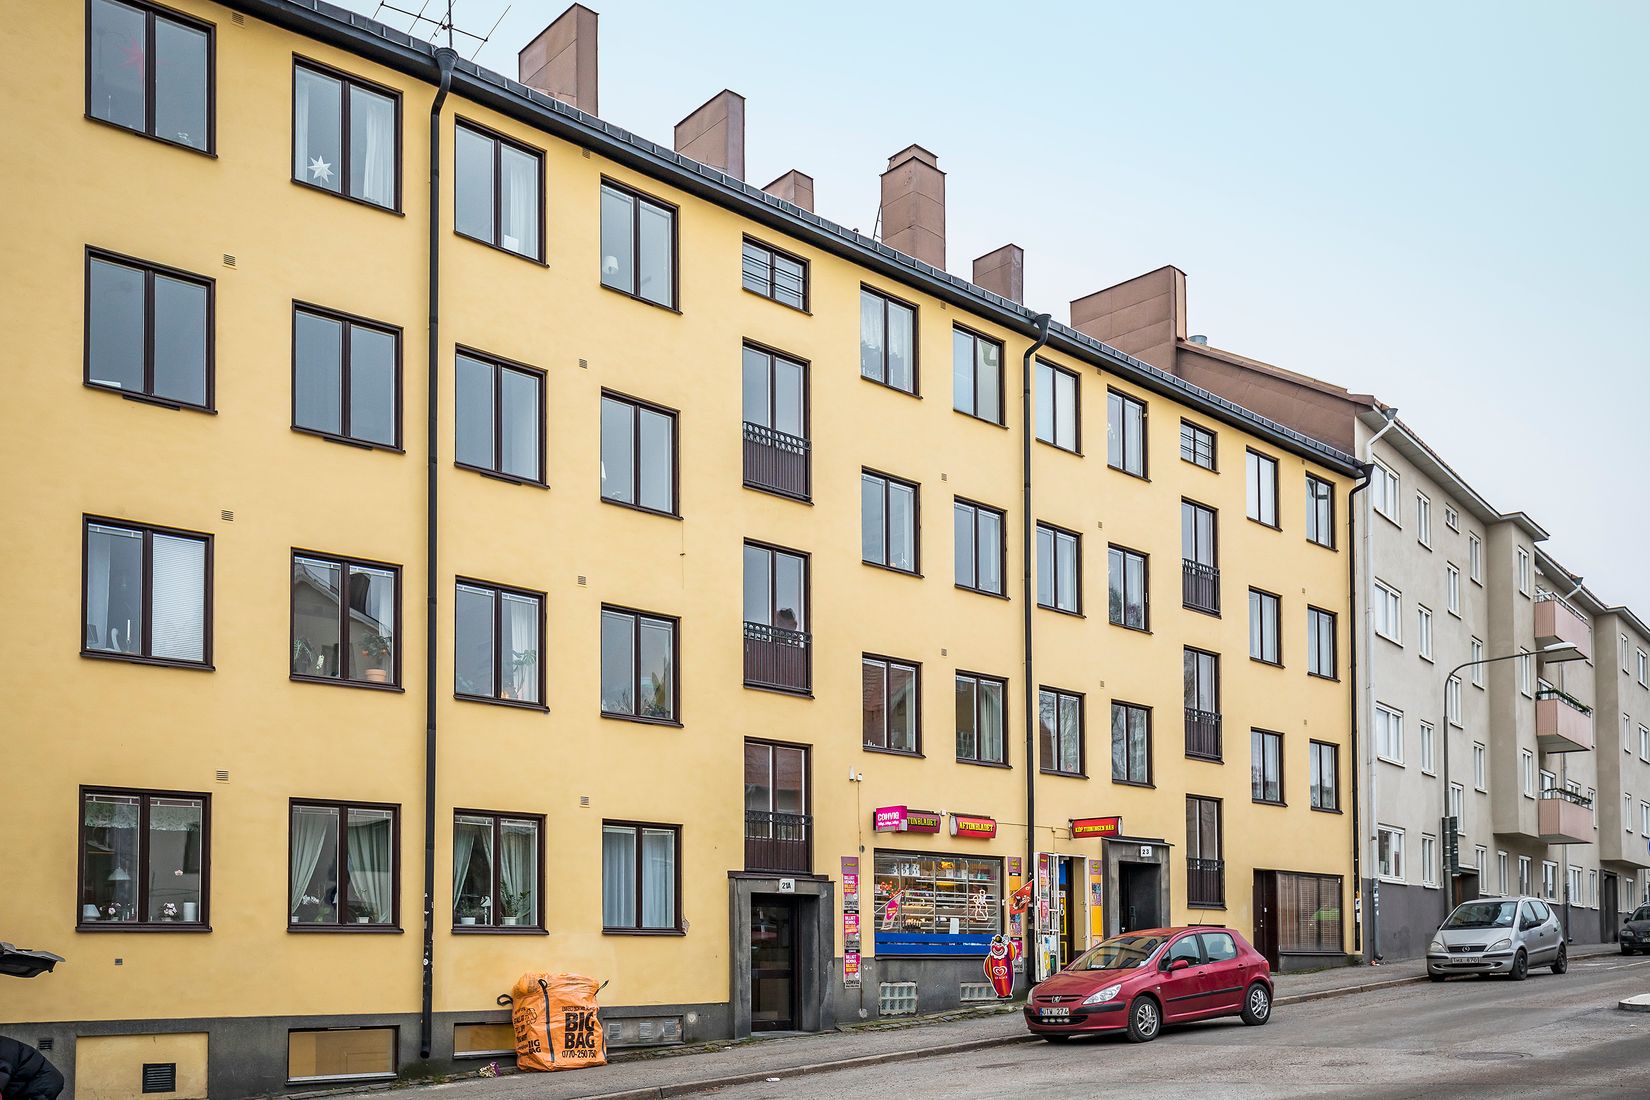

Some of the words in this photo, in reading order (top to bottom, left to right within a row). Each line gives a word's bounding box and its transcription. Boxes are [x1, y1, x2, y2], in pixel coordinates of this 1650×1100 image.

[907, 816, 937, 827] TONBLADET
[959, 821, 993, 832] AFTONBLADET
[565, 1012, 595, 1032] BIG
[564, 1032, 595, 1049] BAG
